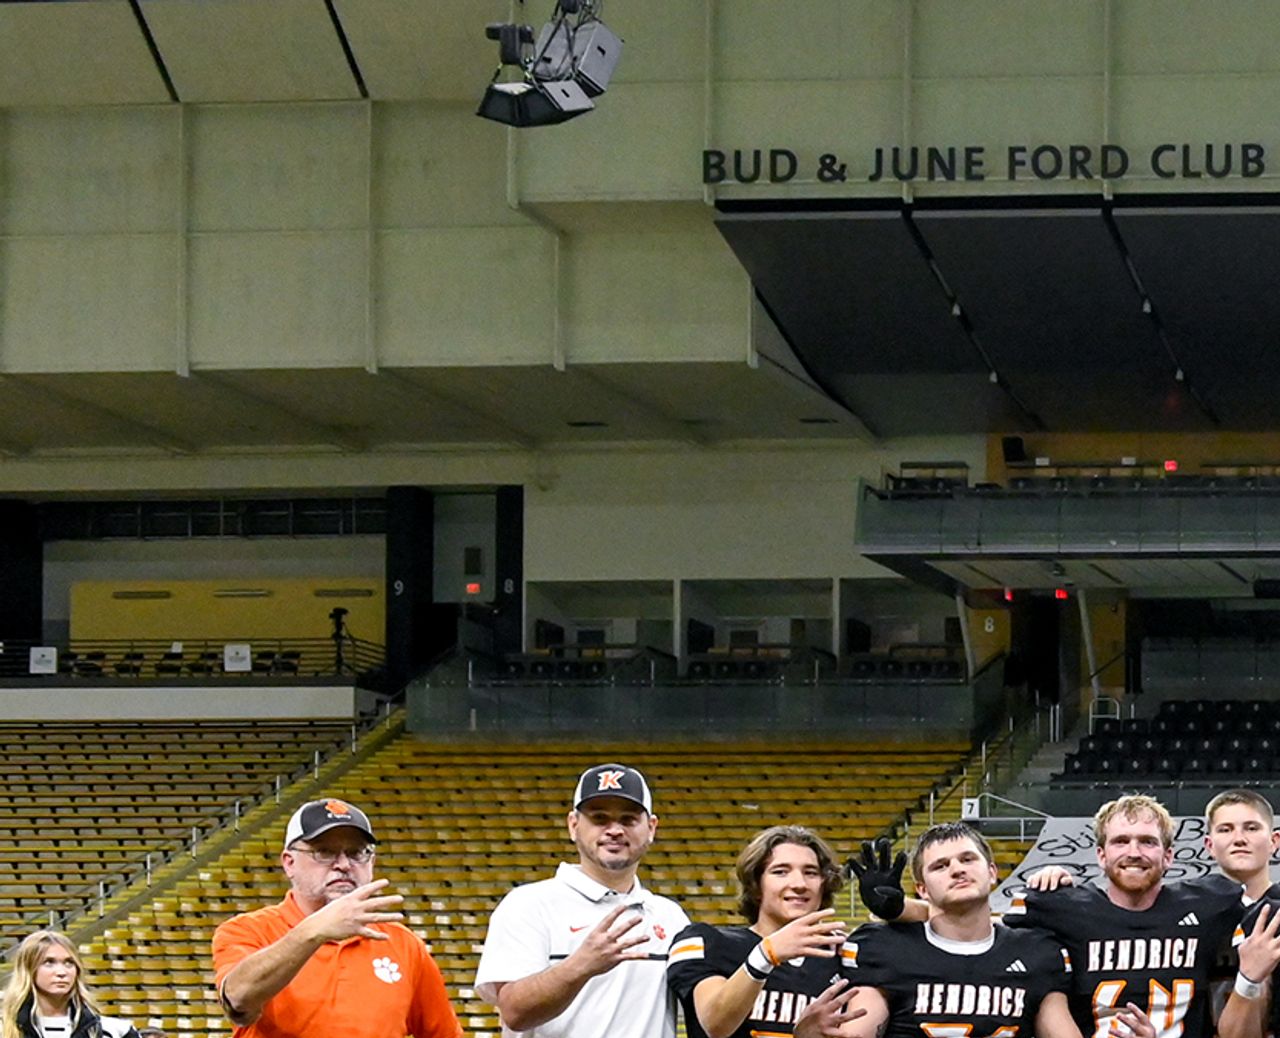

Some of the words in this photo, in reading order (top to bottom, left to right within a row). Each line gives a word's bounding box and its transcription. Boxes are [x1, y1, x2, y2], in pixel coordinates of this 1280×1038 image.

[702, 149, 798, 184] BUD
[816, 154, 847, 183] &
[868, 147, 985, 182] JUNE
[1008, 144, 1129, 181] FORD
[1151, 143, 1266, 178] CLUB
[394, 580, 404, 596] 9
[504, 578, 514, 594] 8
[985, 616, 994, 632] 8
[597, 770, 626, 791] K
[967, 802, 974, 815] 7
[1087, 938, 1199, 973] KENDRICK
[914, 983, 1026, 1018] KENDRICK
